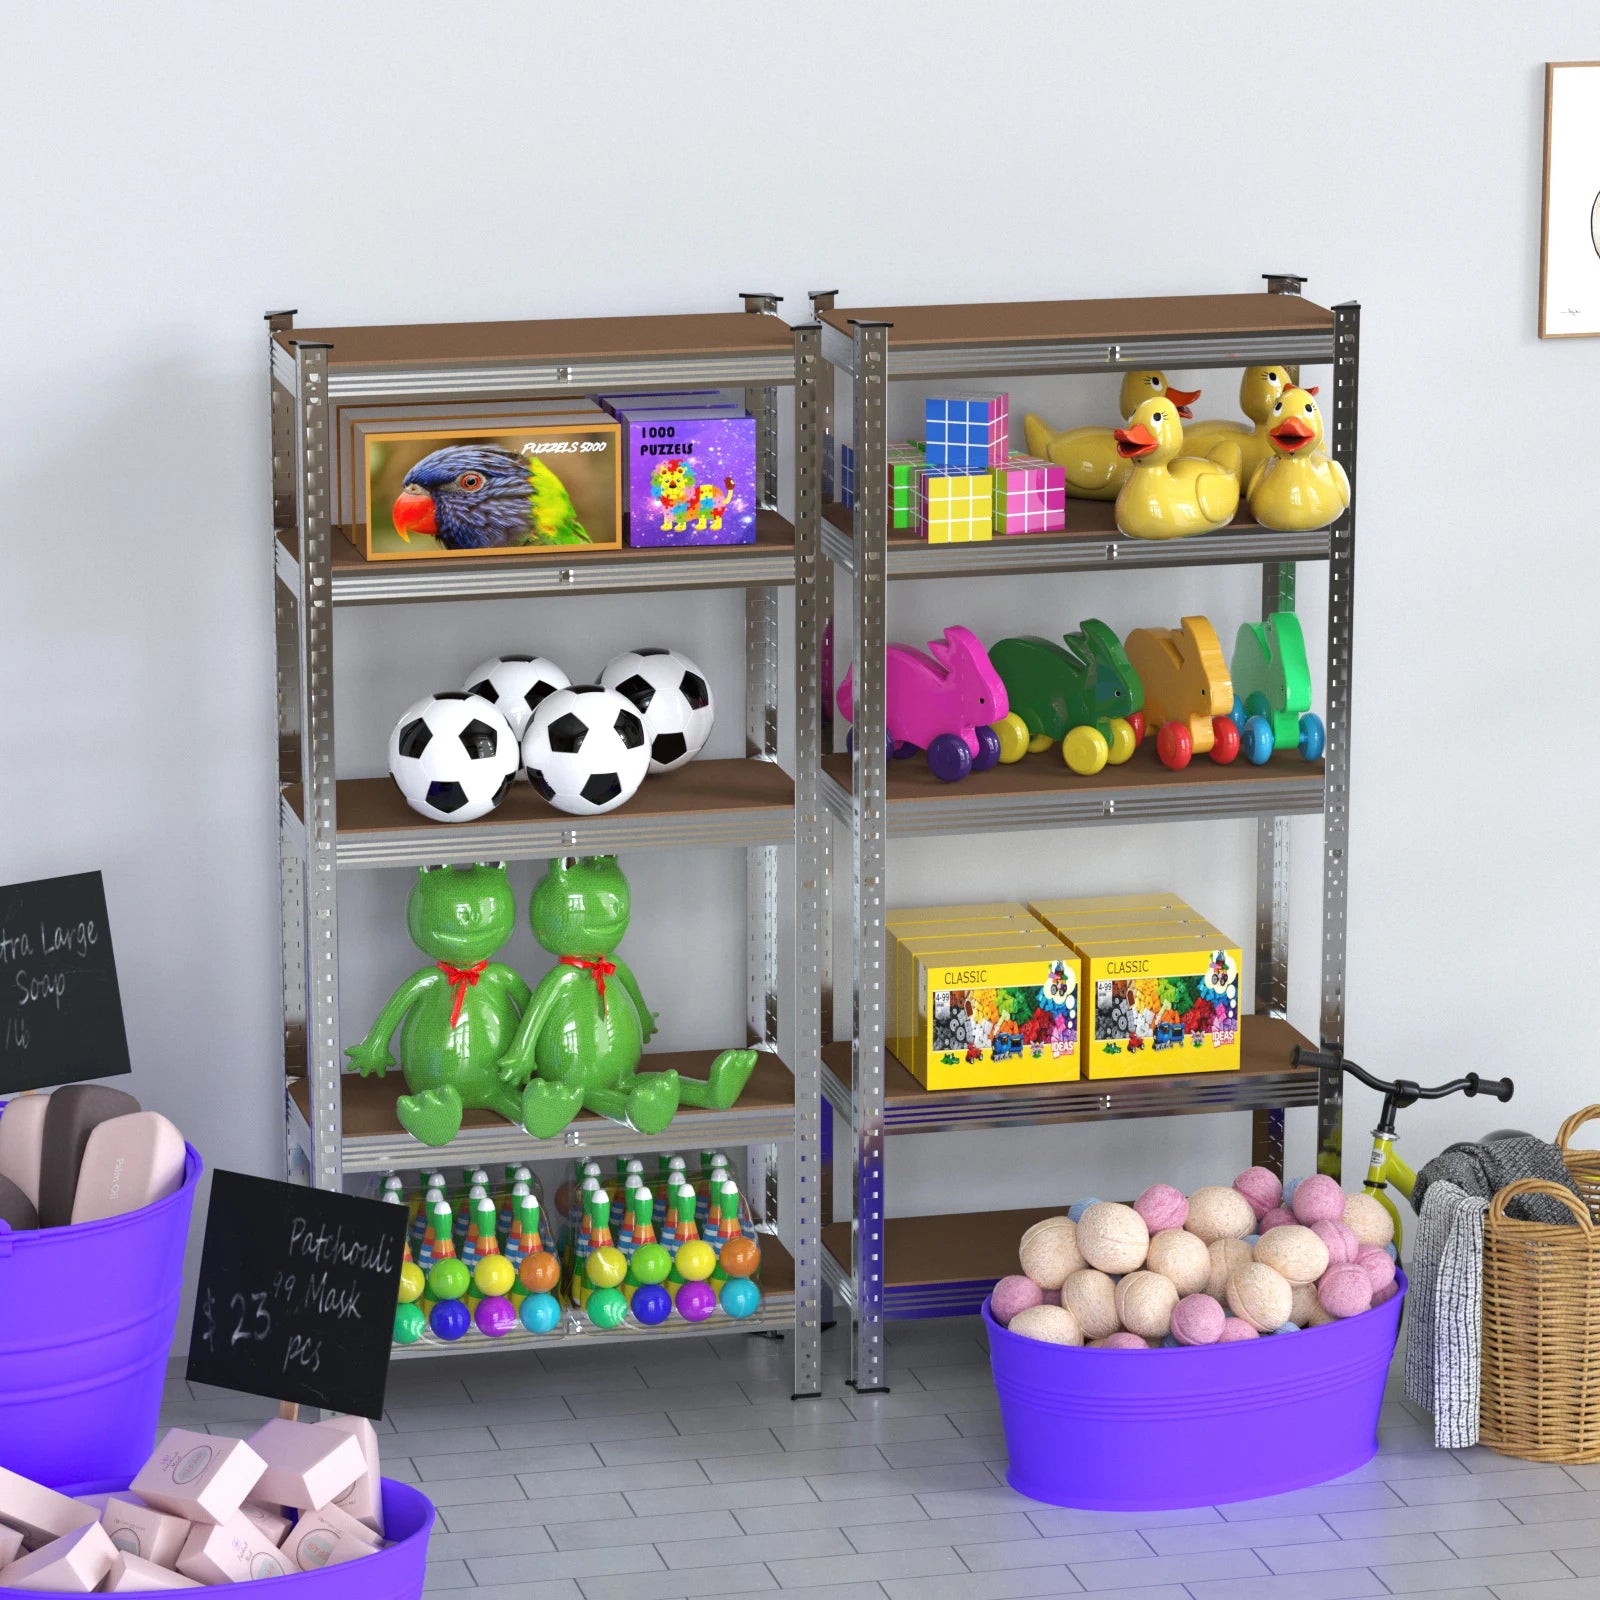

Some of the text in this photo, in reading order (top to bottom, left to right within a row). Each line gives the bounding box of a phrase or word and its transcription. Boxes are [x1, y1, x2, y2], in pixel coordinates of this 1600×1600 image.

[641, 426, 676, 439] 1000
[521, 441, 607, 454] PUZZELS 5000
[640, 443, 693, 456] PUZZELS
[0, 920, 98, 963] tra Large
[1106, 959, 1150, 975] CLASSIC
[944, 969, 988, 985] CLASSIC
[15, 969, 66, 1010] Soap
[935, 992, 950, 1002] 4-99
[1212, 1030, 1234, 1041] IDEAS
[1052, 1040, 1074, 1052] IDEAS
[289, 1216, 394, 1274] Patchouli
[304, 1271, 362, 1319] Mask
[282, 1334, 321, 1373] pcs
